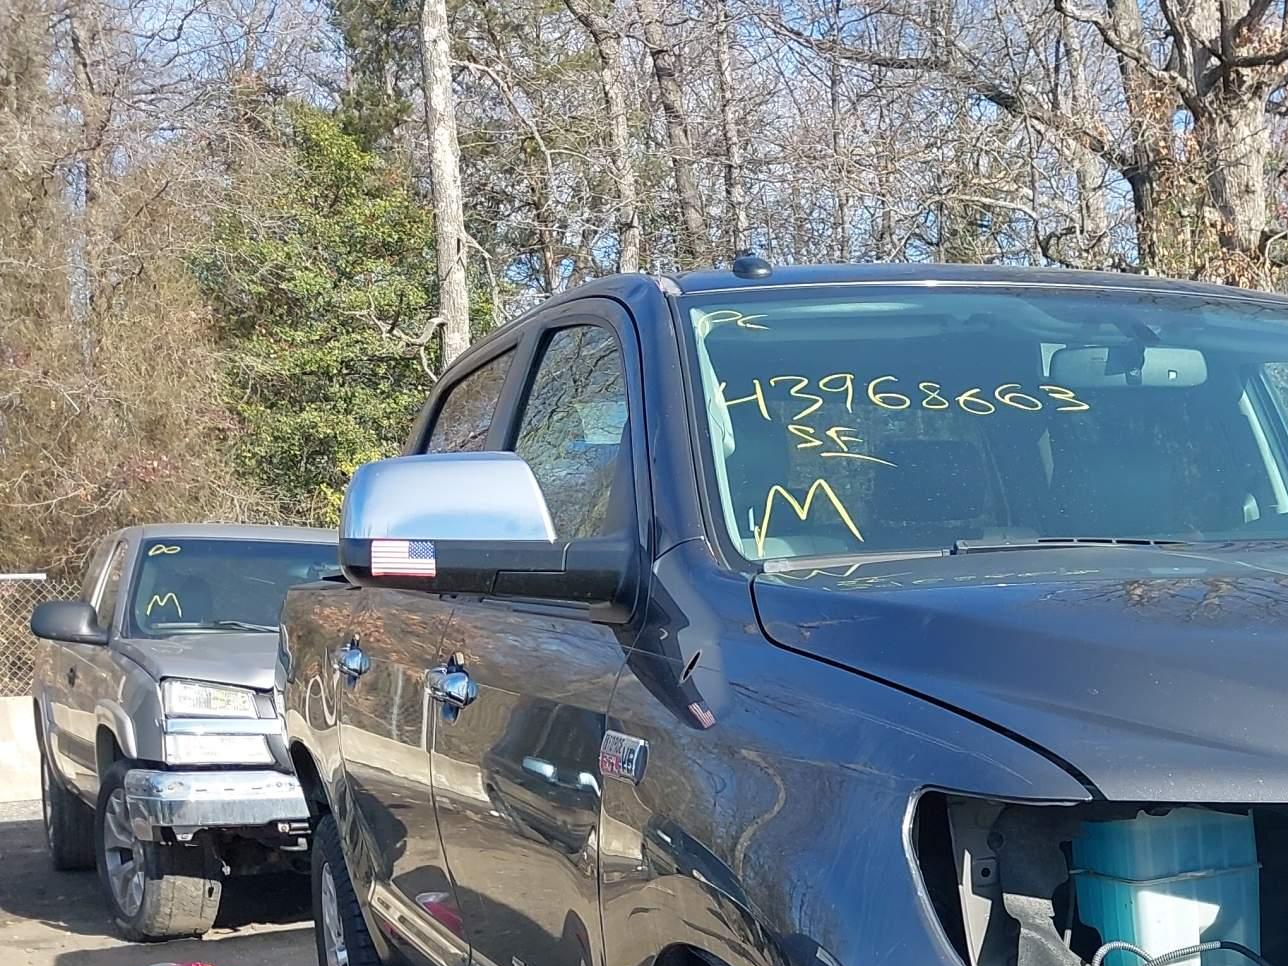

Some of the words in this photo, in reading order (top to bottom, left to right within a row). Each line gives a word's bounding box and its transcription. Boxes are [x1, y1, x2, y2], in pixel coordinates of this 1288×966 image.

[718, 373, 1090, 421] 43968663
[753, 479, 864, 557] M
[147, 593, 182, 618] M
